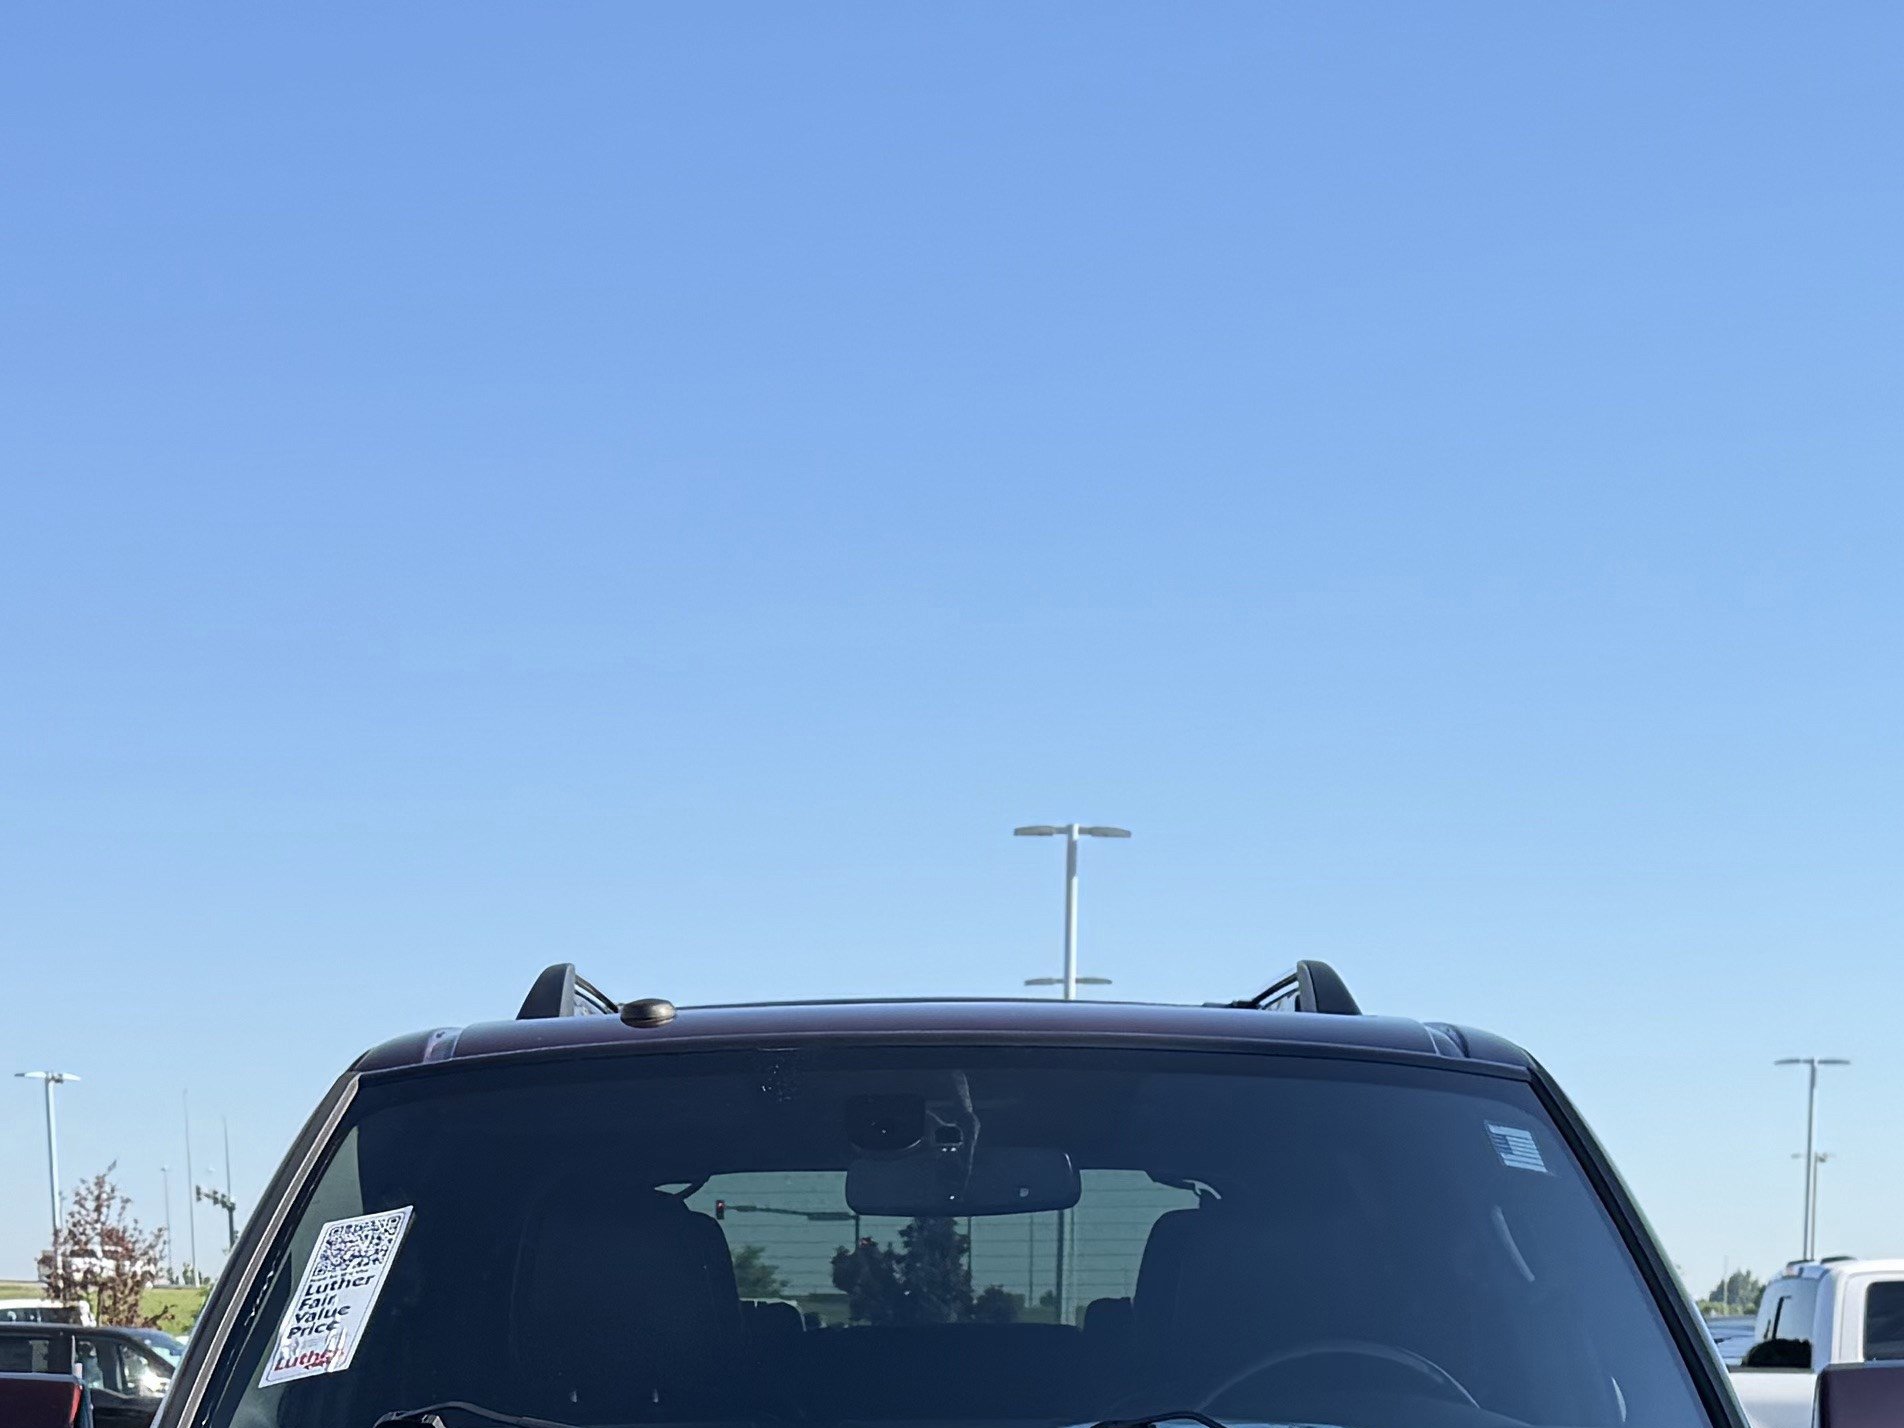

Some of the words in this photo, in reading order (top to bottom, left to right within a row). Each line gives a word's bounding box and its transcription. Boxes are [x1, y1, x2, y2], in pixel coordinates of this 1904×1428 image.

[304, 1274, 376, 1297] Luther
[298, 1293, 336, 1312] Fair
[295, 1305, 351, 1324] Value
[287, 1320, 340, 1340] Price
